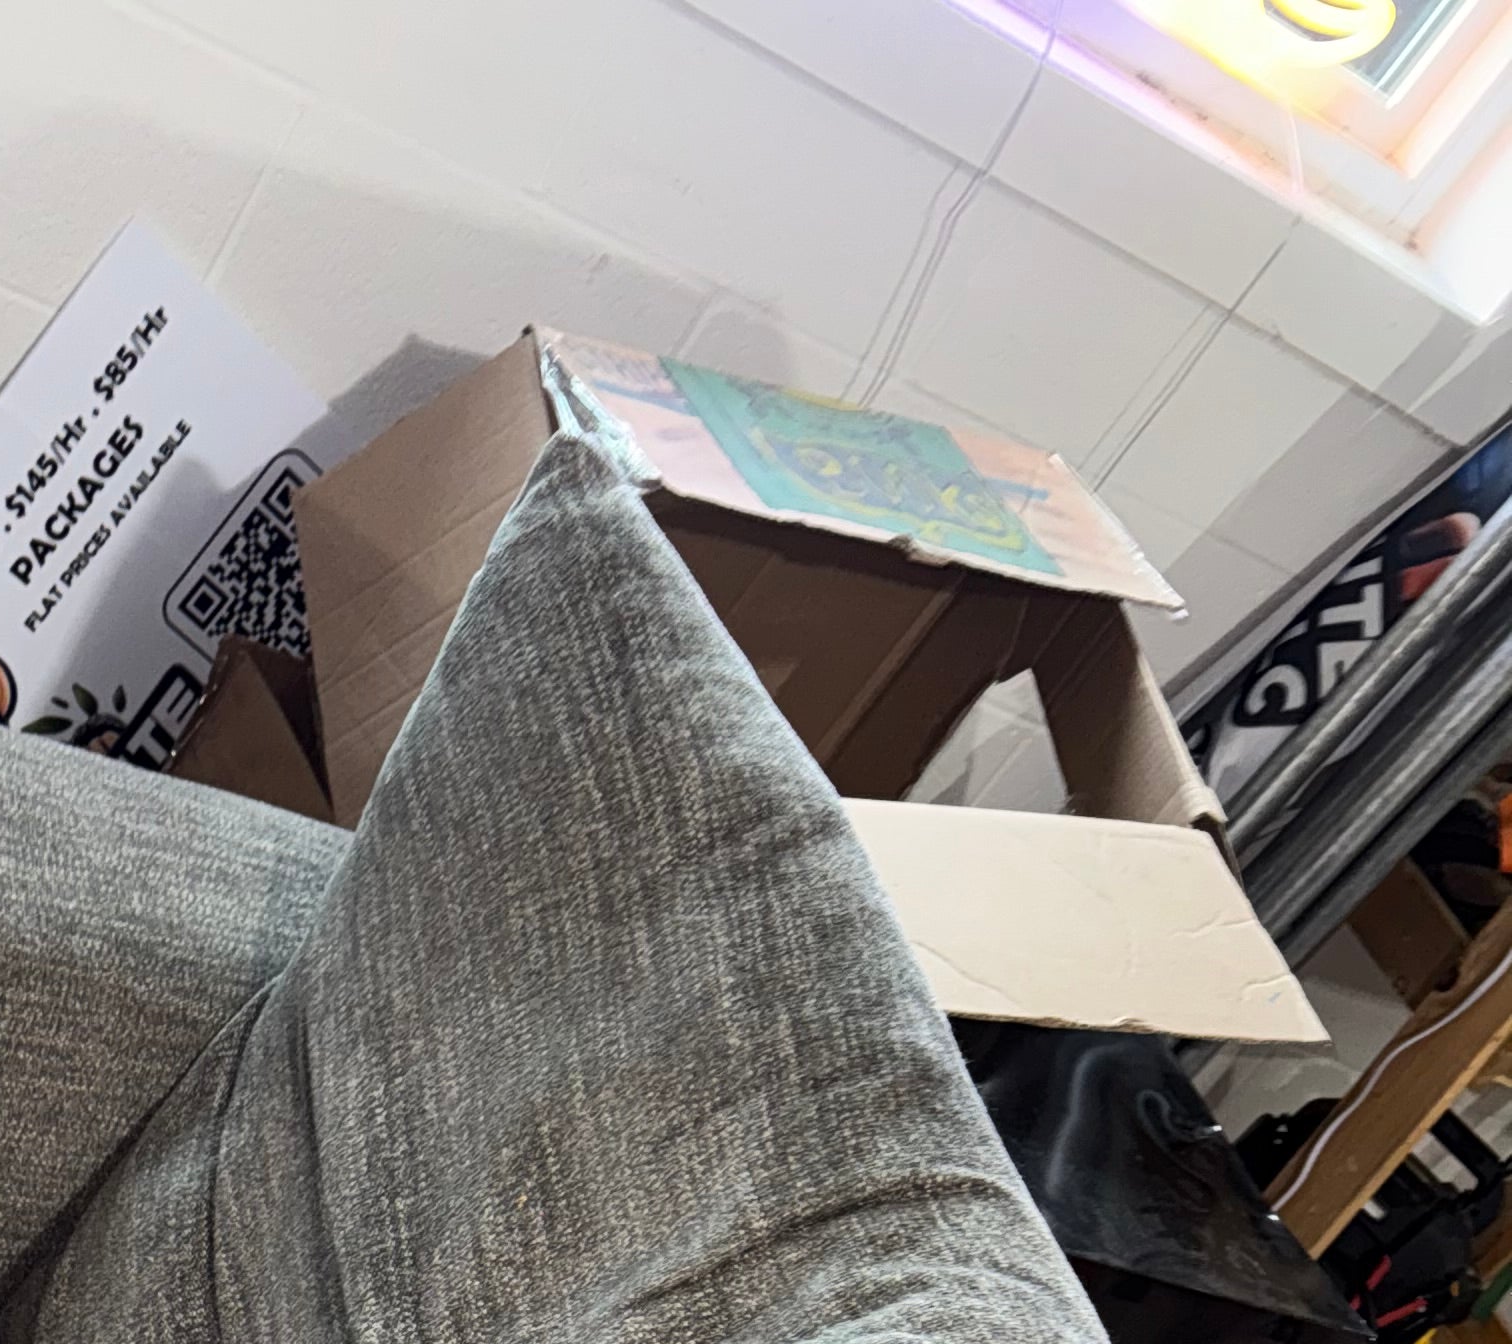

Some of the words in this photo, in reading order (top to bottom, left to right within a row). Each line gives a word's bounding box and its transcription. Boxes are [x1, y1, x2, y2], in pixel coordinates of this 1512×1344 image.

[5, 416, 88, 518] $145/Hr
[93, 306, 169, 401] $85/Hr
[9, 415, 144, 585] PACKAGES
[24, 584, 64, 633] FLAT
[60, 524, 112, 588] PRICES
[110, 419, 192, 527] AVAILABLE
